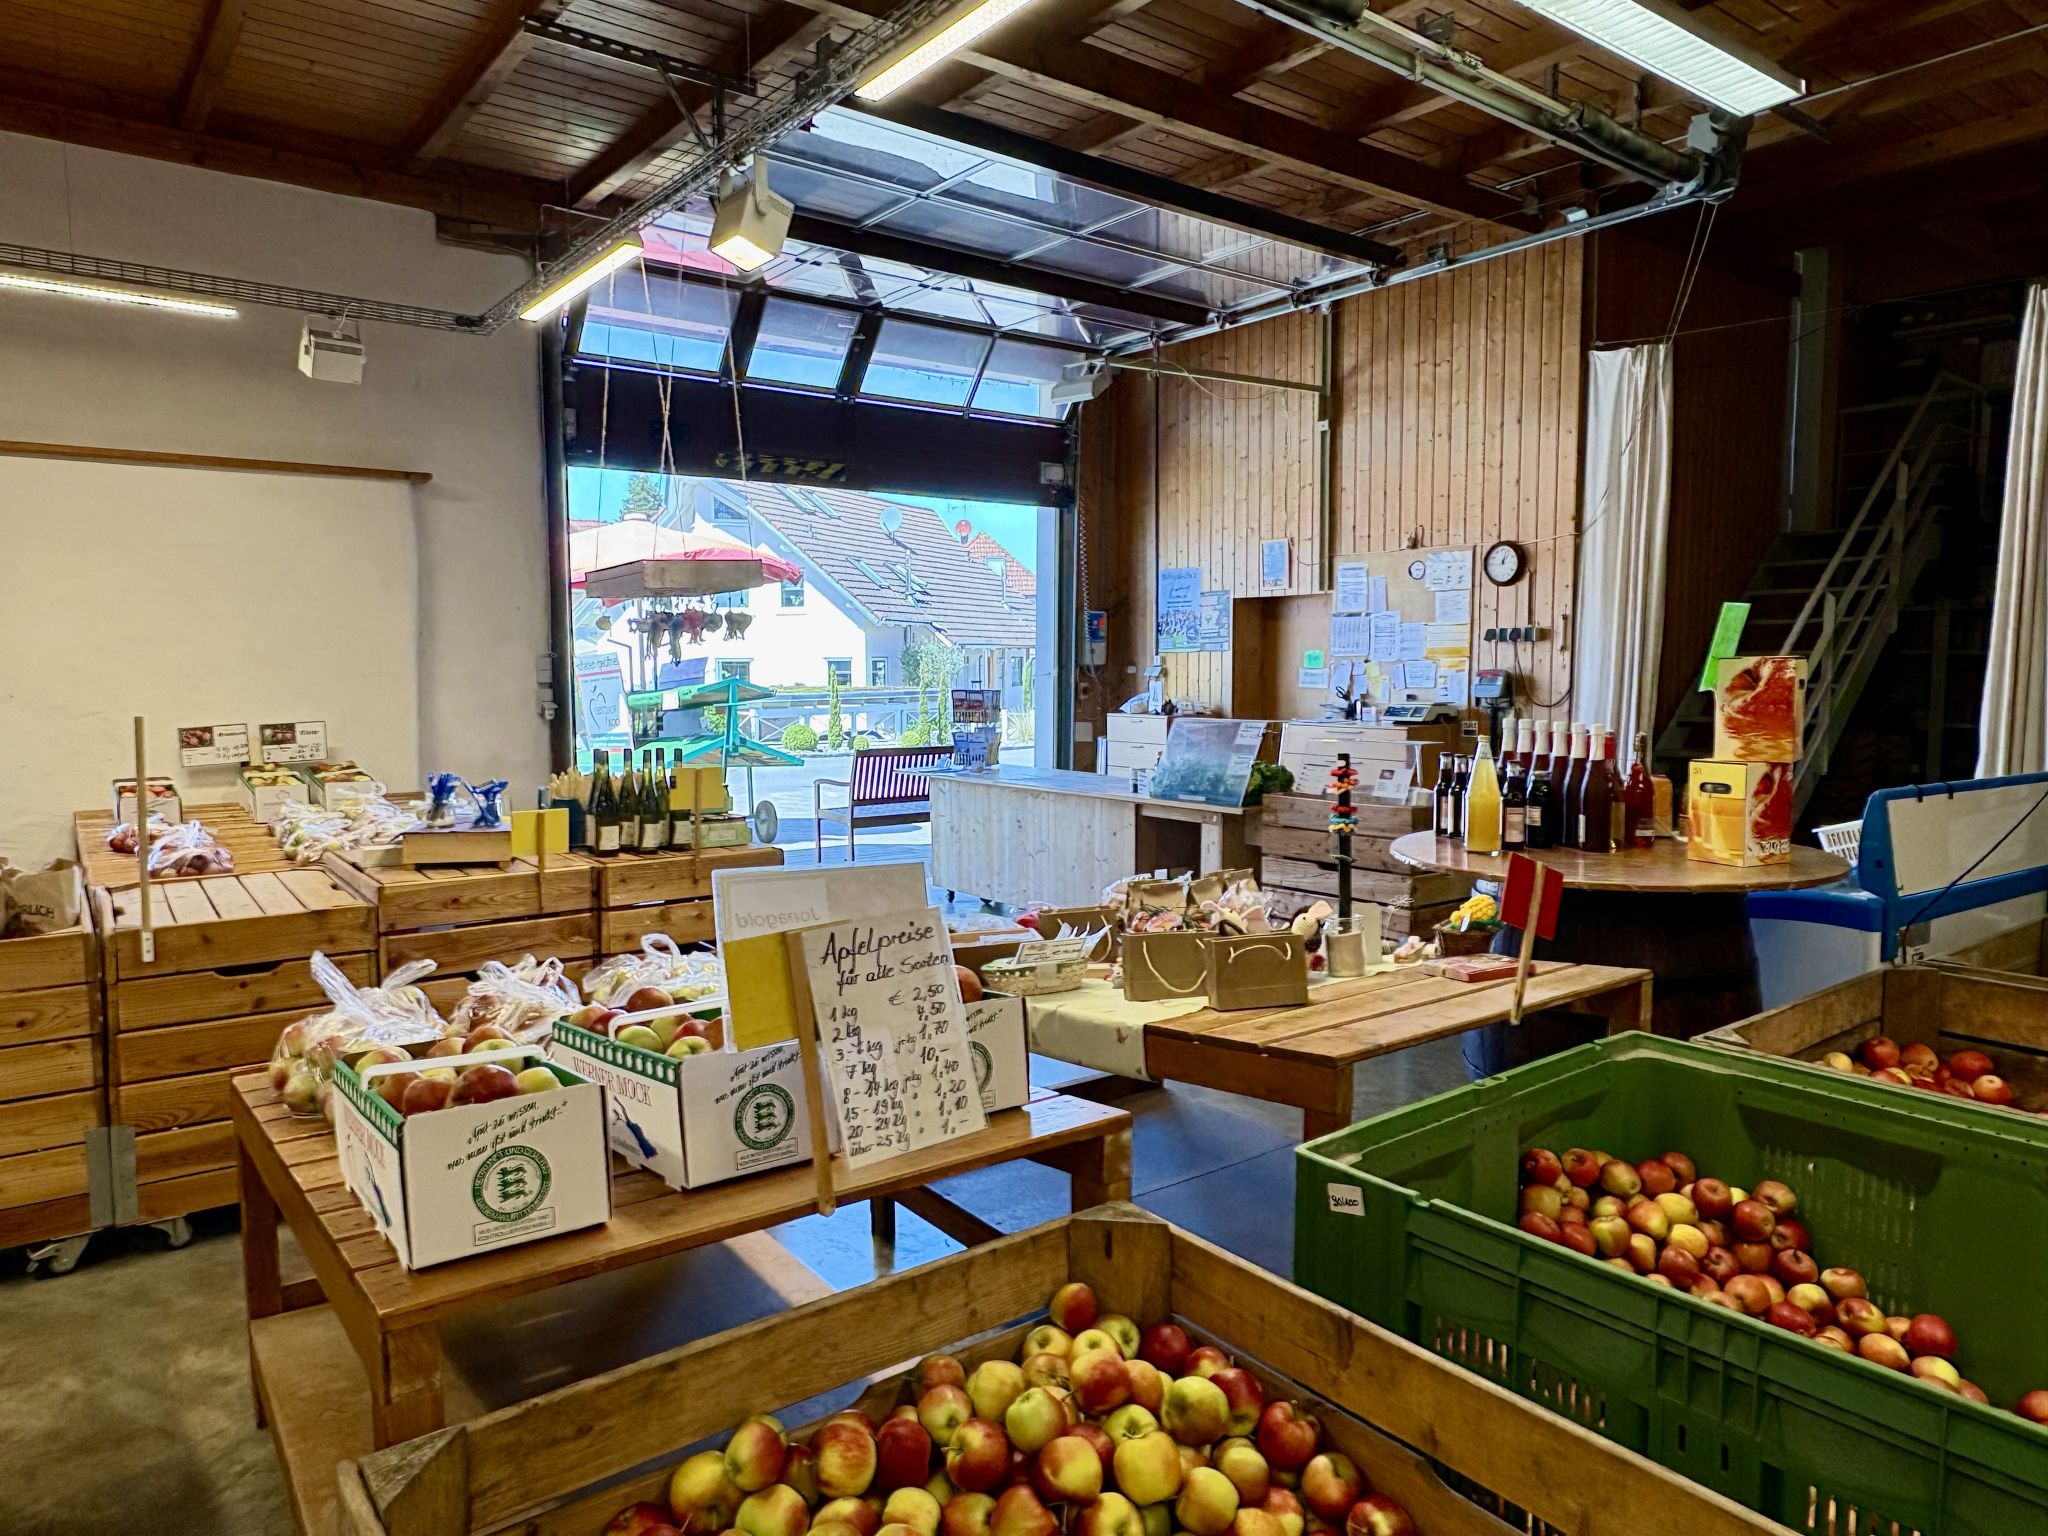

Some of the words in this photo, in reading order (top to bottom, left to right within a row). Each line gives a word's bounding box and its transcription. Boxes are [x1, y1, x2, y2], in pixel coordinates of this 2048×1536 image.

[820, 921, 935, 974] Apfelpreise
[837, 968, 860, 996] für
[866, 965, 895, 982] alle
[901, 952, 949, 974] Sorten
[830, 1006, 837, 1022] 1
[842, 1005, 858, 1025] kg
[888, 990, 904, 1006] €
[912, 984, 945, 1001] 2,50
[832, 1028, 846, 1043] 2
[846, 1021, 861, 1047] kg
[866, 1040, 883, 1060] kg
[919, 1020, 949, 1040] 1,70
[573, 1056, 616, 1092] WERNER
[616, 1074, 652, 1106] MOCK
[846, 1065, 857, 1079] 7
[862, 1061, 877, 1081] kg
[884, 1078, 899, 1099] kg
[930, 1060, 960, 1078] 1,40
[890, 1100, 904, 1116] kg
[934, 1079, 966, 1099] 1,20
[892, 1113, 907, 1135] kg
[939, 1095, 969, 1116] 1,10
[850, 1142, 876, 1157] über
[876, 1135, 894, 1147] 25
[896, 1131, 911, 1151] kg
